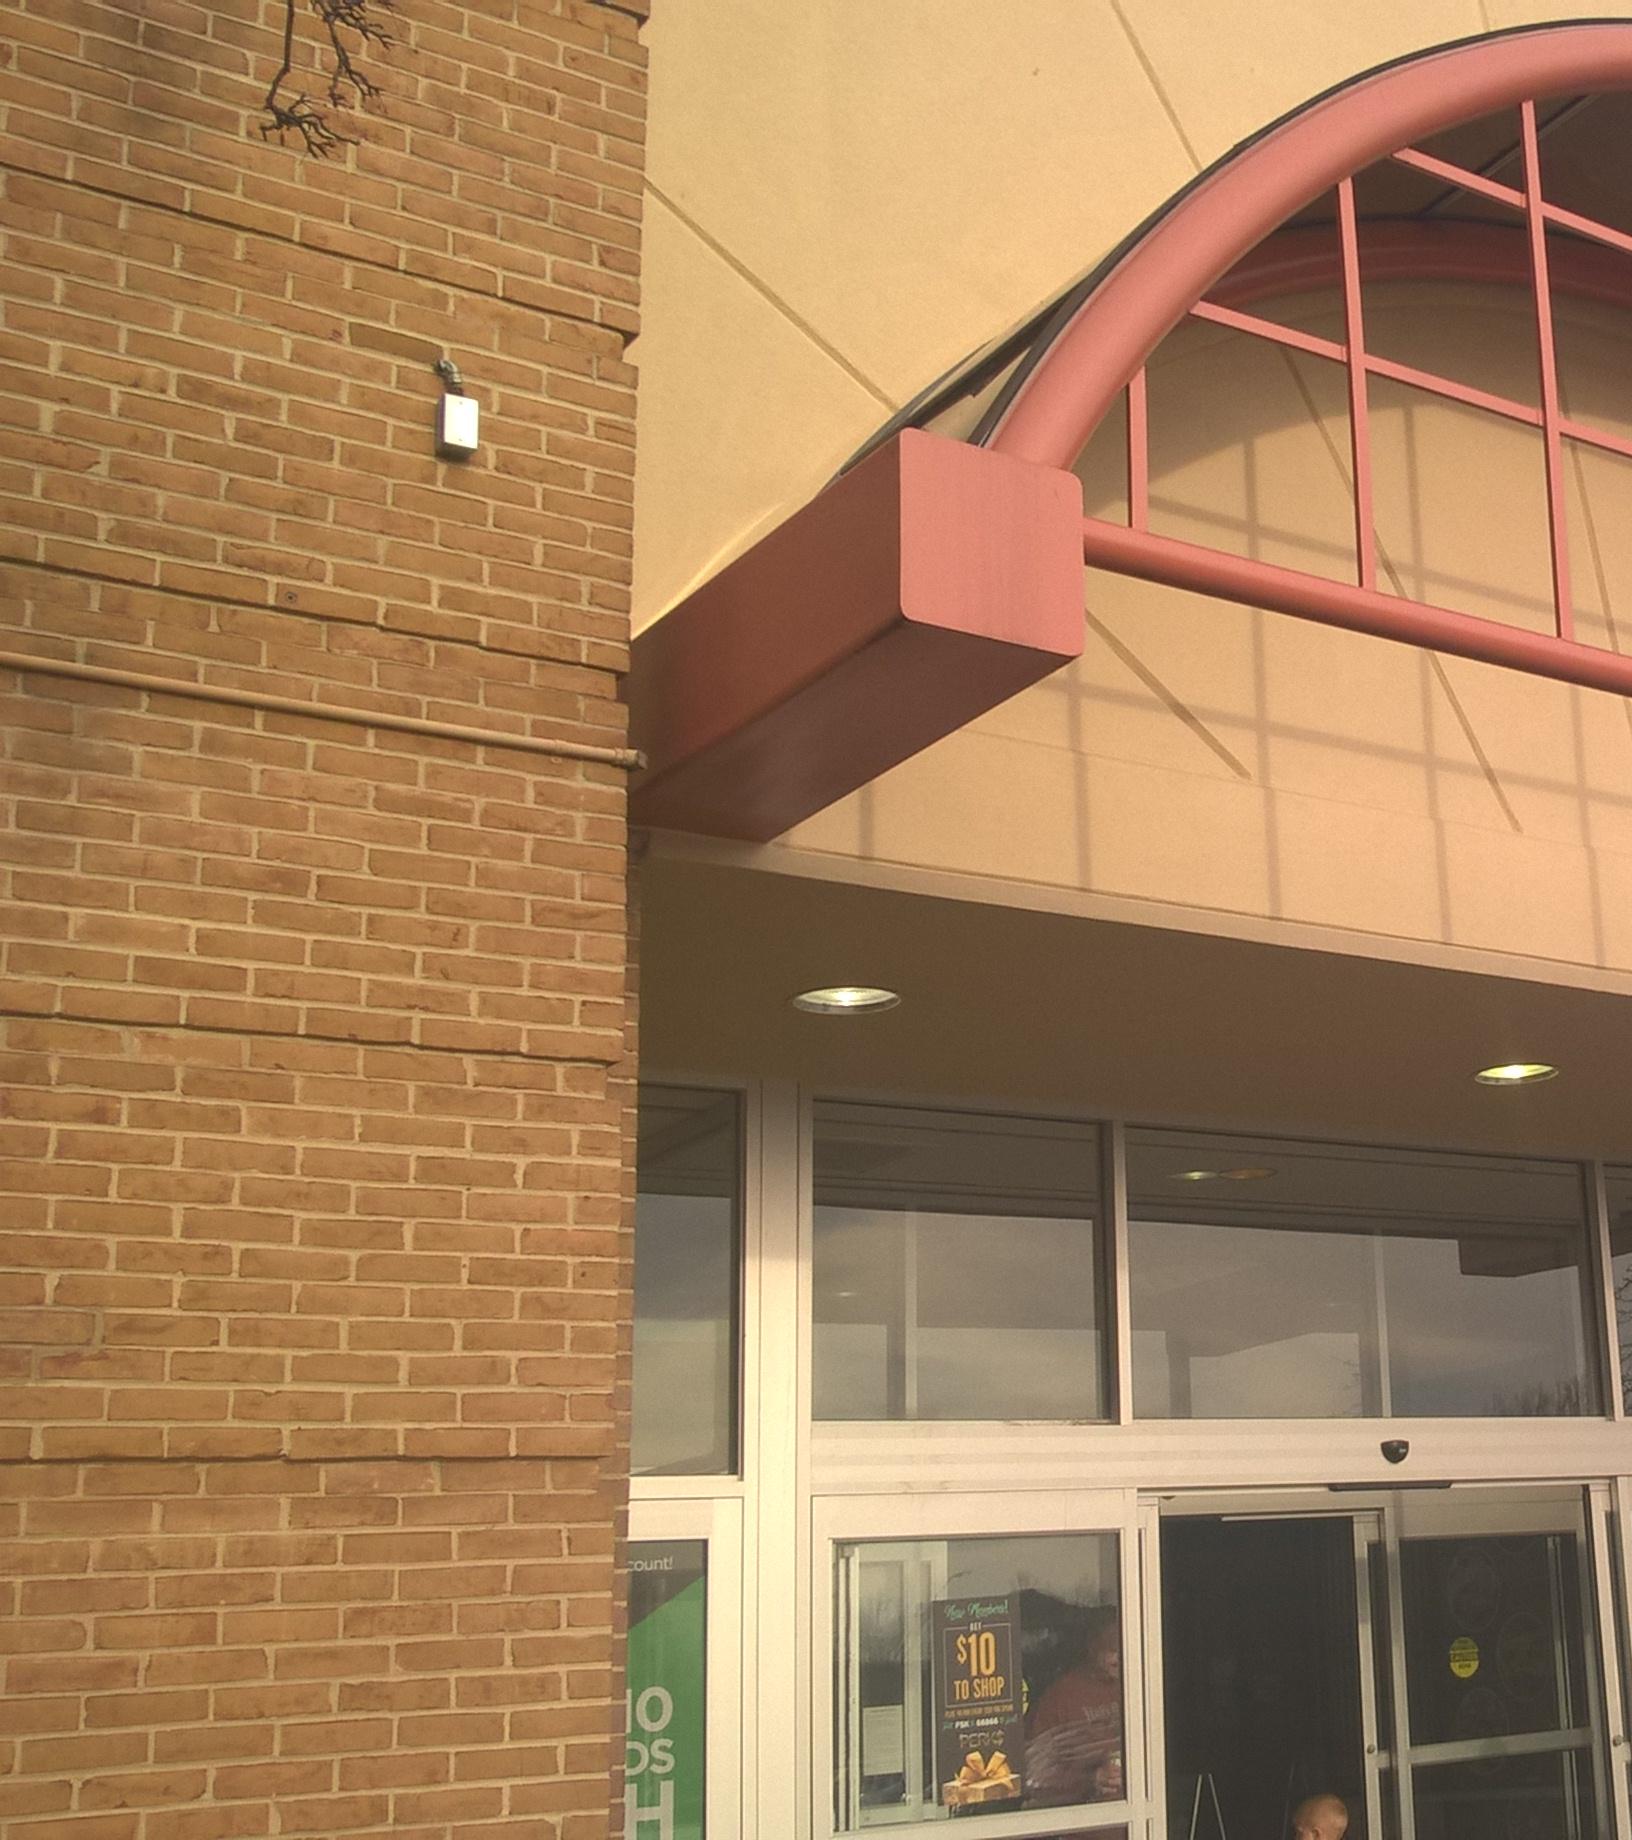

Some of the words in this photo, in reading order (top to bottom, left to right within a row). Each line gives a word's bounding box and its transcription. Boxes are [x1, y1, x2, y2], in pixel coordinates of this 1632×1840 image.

[956, 1631, 996, 1677] $10
[953, 1680, 970, 1700] TO
[973, 1676, 1005, 1699] SHOP
